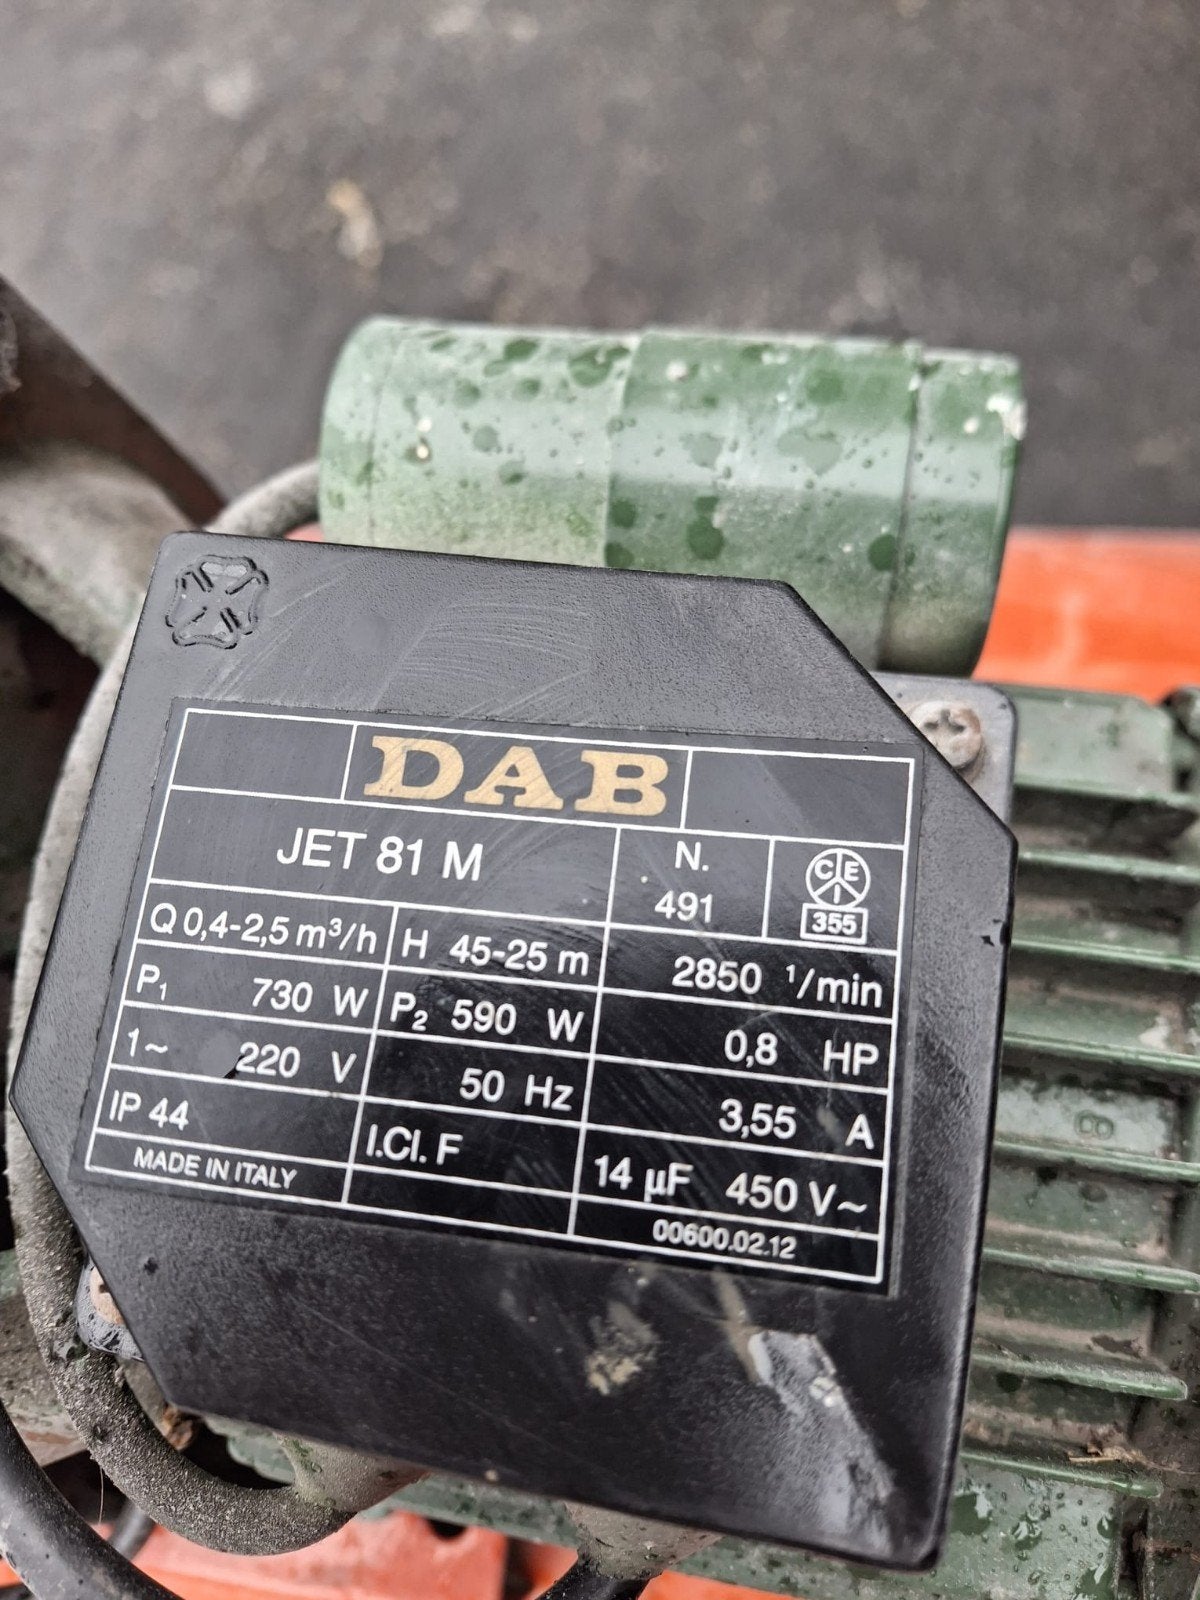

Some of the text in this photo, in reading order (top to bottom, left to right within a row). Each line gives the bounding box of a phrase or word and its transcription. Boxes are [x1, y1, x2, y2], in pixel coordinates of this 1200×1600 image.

[363, 735, 669, 817] DAB
[277, 827, 483, 881] JET 81 M
[674, 840, 710, 872] N.
[150, 902, 178, 935] Q
[183, 906, 290, 949] 0,4-2,5
[654, 890, 714, 924] 491
[811, 911, 858, 936] 355
[401, 925, 590, 977] H 45-25 m
[671, 955, 762, 995] 2850
[252, 977, 313, 1013] 730
[334, 984, 369, 1019] W
[450, 998, 517, 1036] 590
[547, 1007, 585, 1043] W
[235, 1041, 300, 1078] 220
[331, 1050, 358, 1084] V
[724, 1028, 880, 1077] 0,8 HP
[109, 1090, 189, 1131] IP 44
[459, 1067, 574, 1112] 50 Hz
[718, 1098, 874, 1150] 3,55 A
[132, 1145, 298, 1191] MADE IN ITALY
[436, 1132, 464, 1166] F
[593, 1154, 633, 1191] 14
[725, 1172, 799, 1213] 450
[651, 1218, 797, 1260] 00600.02.12
